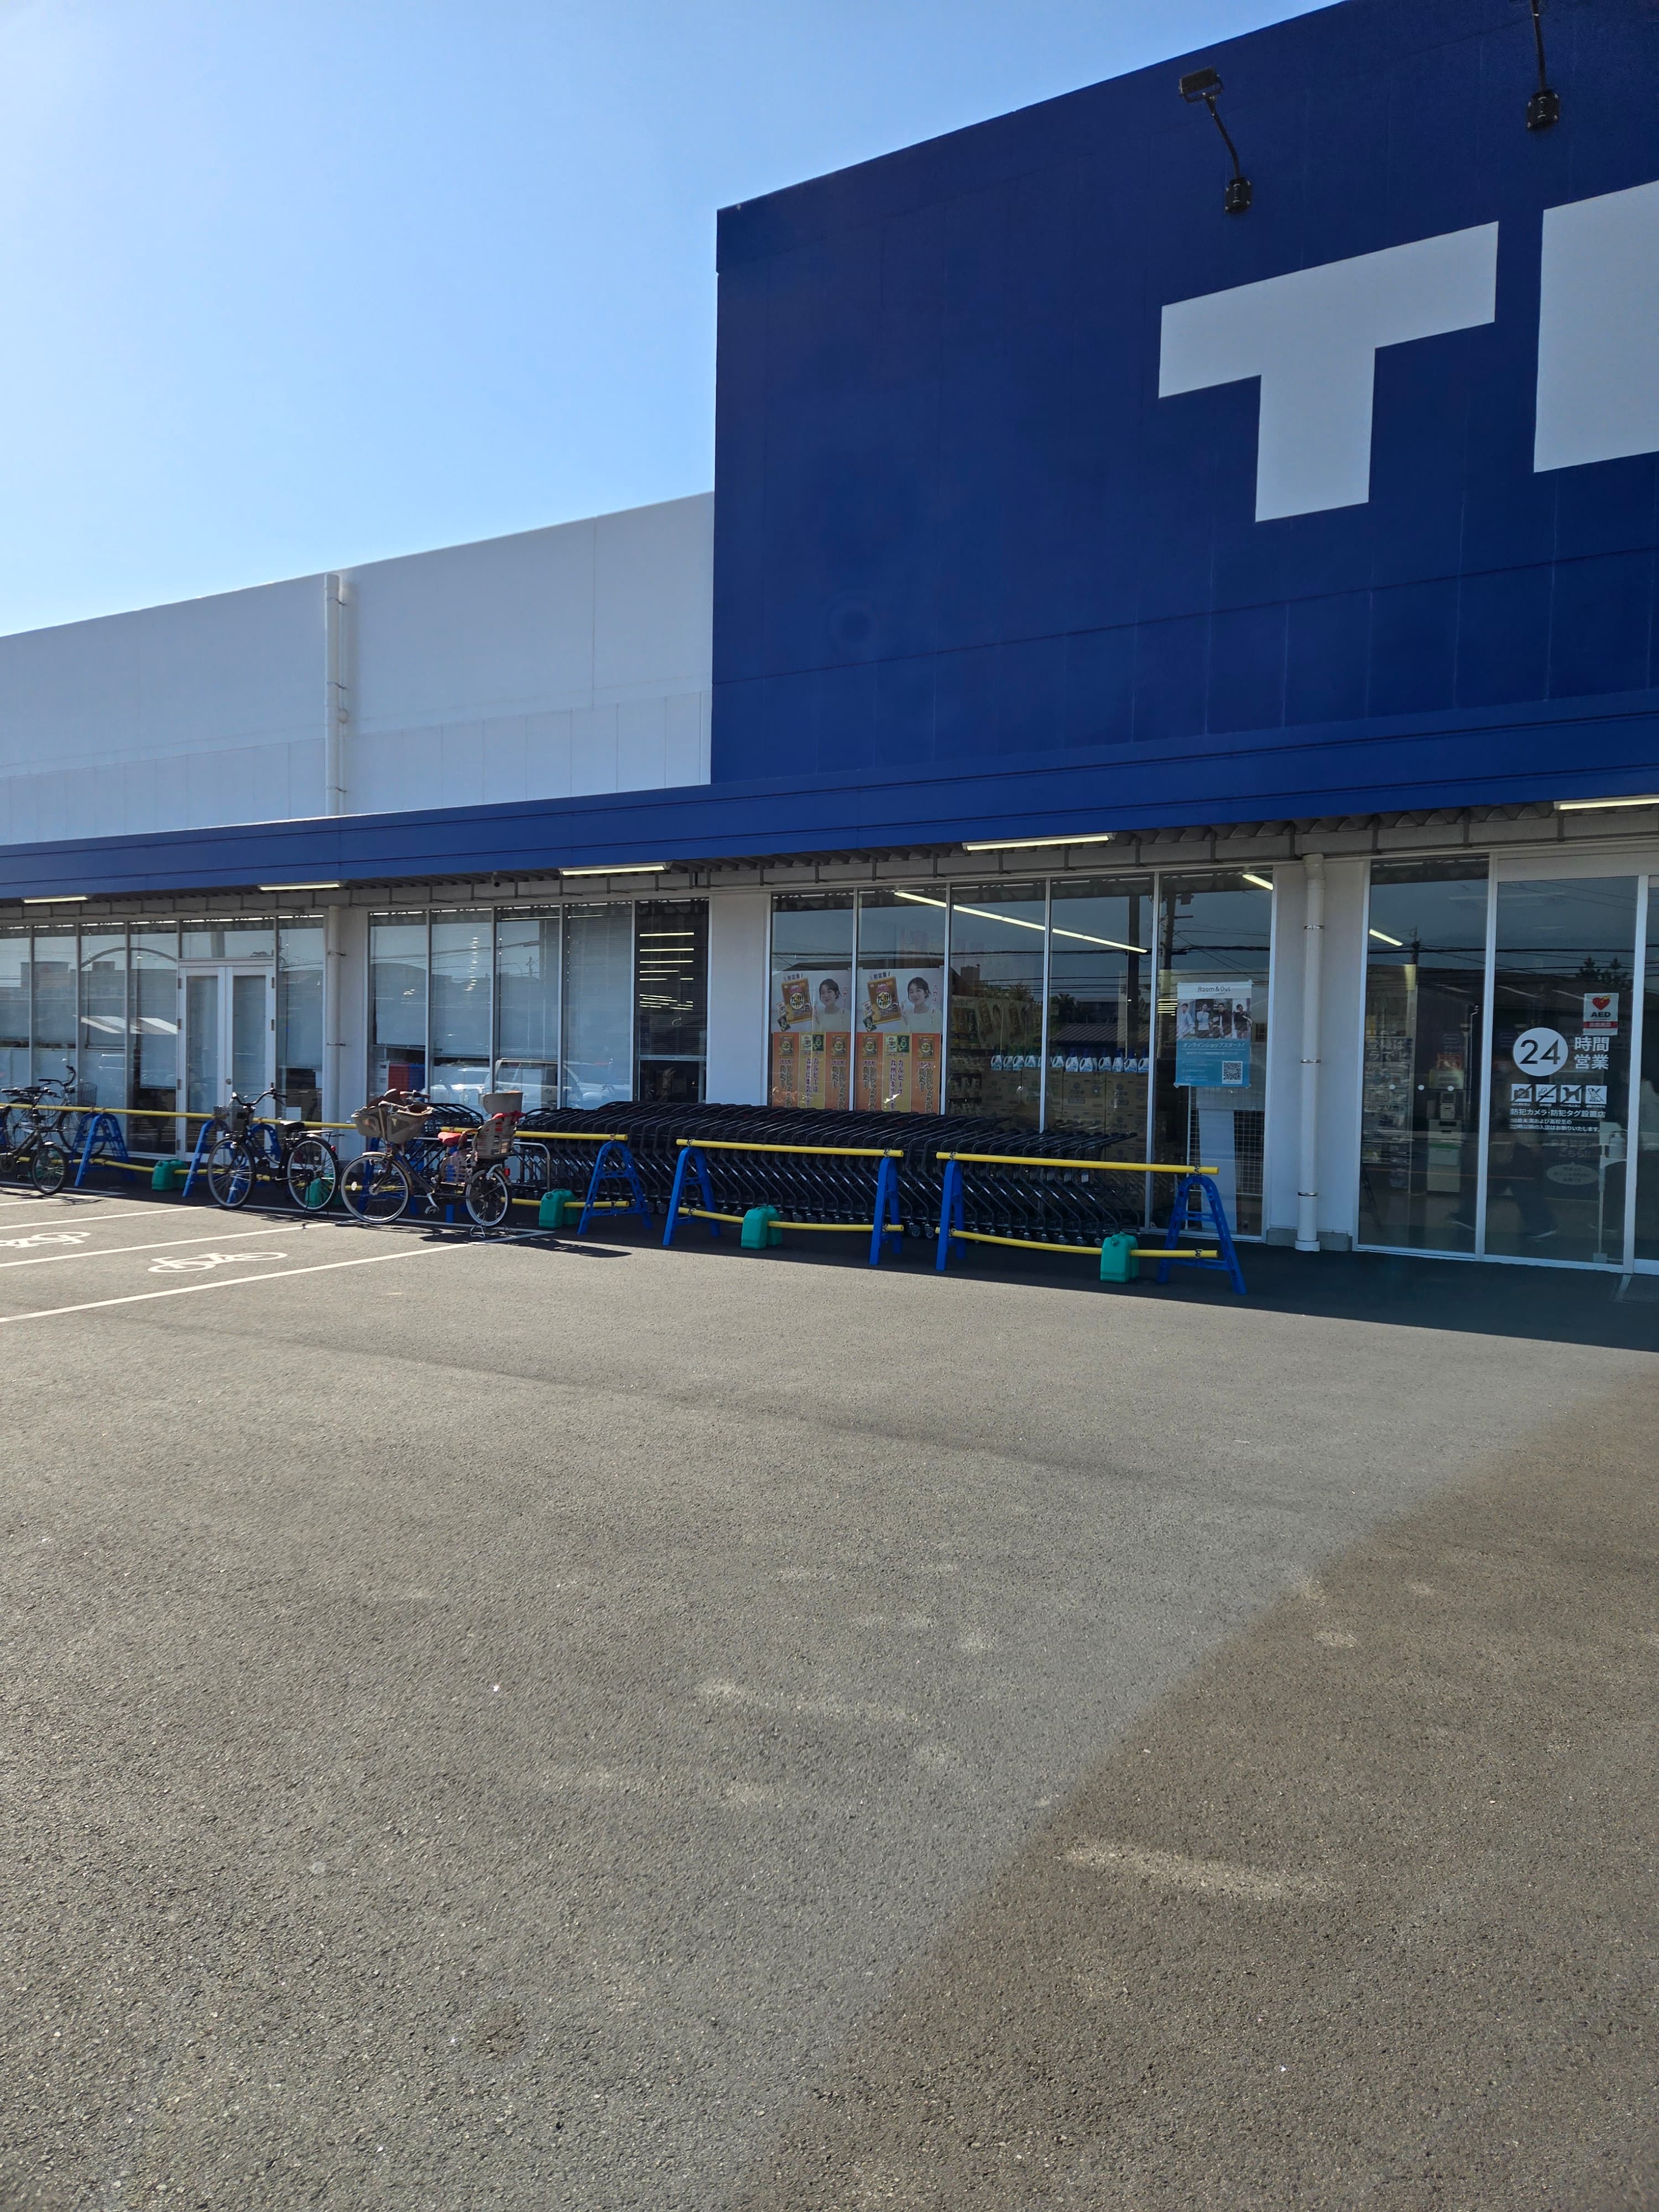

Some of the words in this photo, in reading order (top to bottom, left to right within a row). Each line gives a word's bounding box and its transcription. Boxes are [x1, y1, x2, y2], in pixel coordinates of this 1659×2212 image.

[1520, 1039, 1561, 1065] 24
[1574, 1036, 1610, 1052] 時間
[1574, 1054, 1609, 1070] 営業
